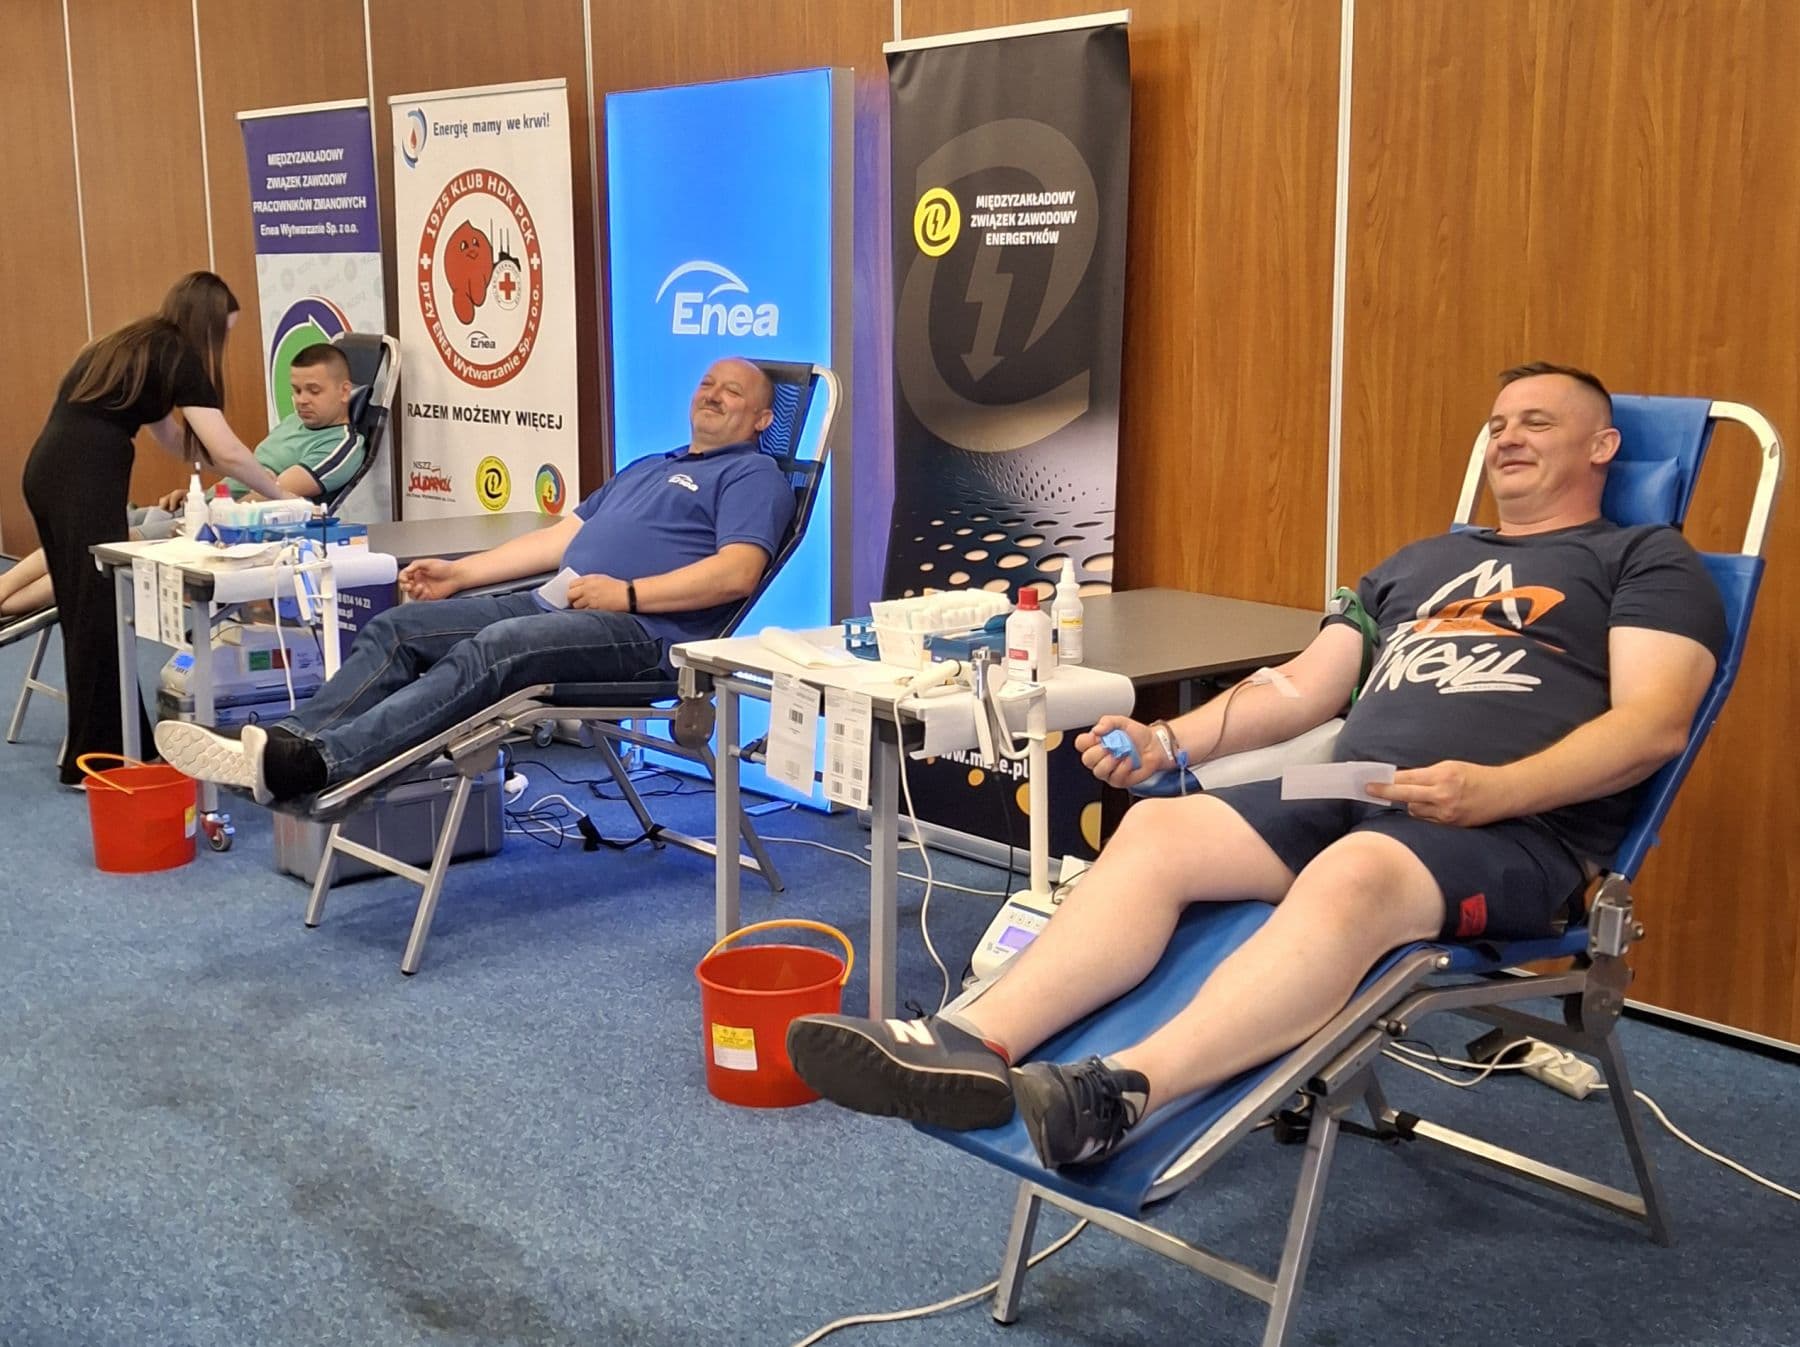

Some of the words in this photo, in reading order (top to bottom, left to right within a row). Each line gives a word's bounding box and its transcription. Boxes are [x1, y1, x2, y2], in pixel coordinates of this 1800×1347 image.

[433, 120, 468, 138] Energię
[472, 119, 501, 136] mamy
[506, 118, 520, 130] we
[523, 112, 550, 129] krwi!
[267, 148, 344, 168] MIĘDZYZAKŁADOWY
[266, 176, 300, 191] ZWIĄZEK
[302, 172, 347, 187] ZAWODOWY
[253, 197, 312, 213] PRACOWNIKÓW
[313, 196, 367, 210] ZMIANOWYCH
[451, 173, 483, 199] KLUB
[487, 175, 515, 207] HDK
[515, 206, 535, 246] PCK
[976, 191, 1076, 210] MIĘDZYZAKŁADOWY
[970, 213, 1015, 230] ZWIĄZEK
[1017, 210, 1077, 226] ZAWODOWY
[260, 224, 279, 236] Enea
[280, 223, 325, 238] Wytwarzanie
[985, 228, 1060, 246] ENERGETYKÓW
[672, 292, 779, 337] Enea
[420, 282, 436, 319] przy
[432, 321, 451, 360] ENEA
[452, 355, 521, 381] Wytwarzanie
[518, 336, 532, 358] Sp.
[470, 337, 496, 349] Enea
[407, 403, 448, 420] RAZEM
[452, 404, 511, 425] MOŻEMY
[516, 410, 563, 432] WIĘCEJ
